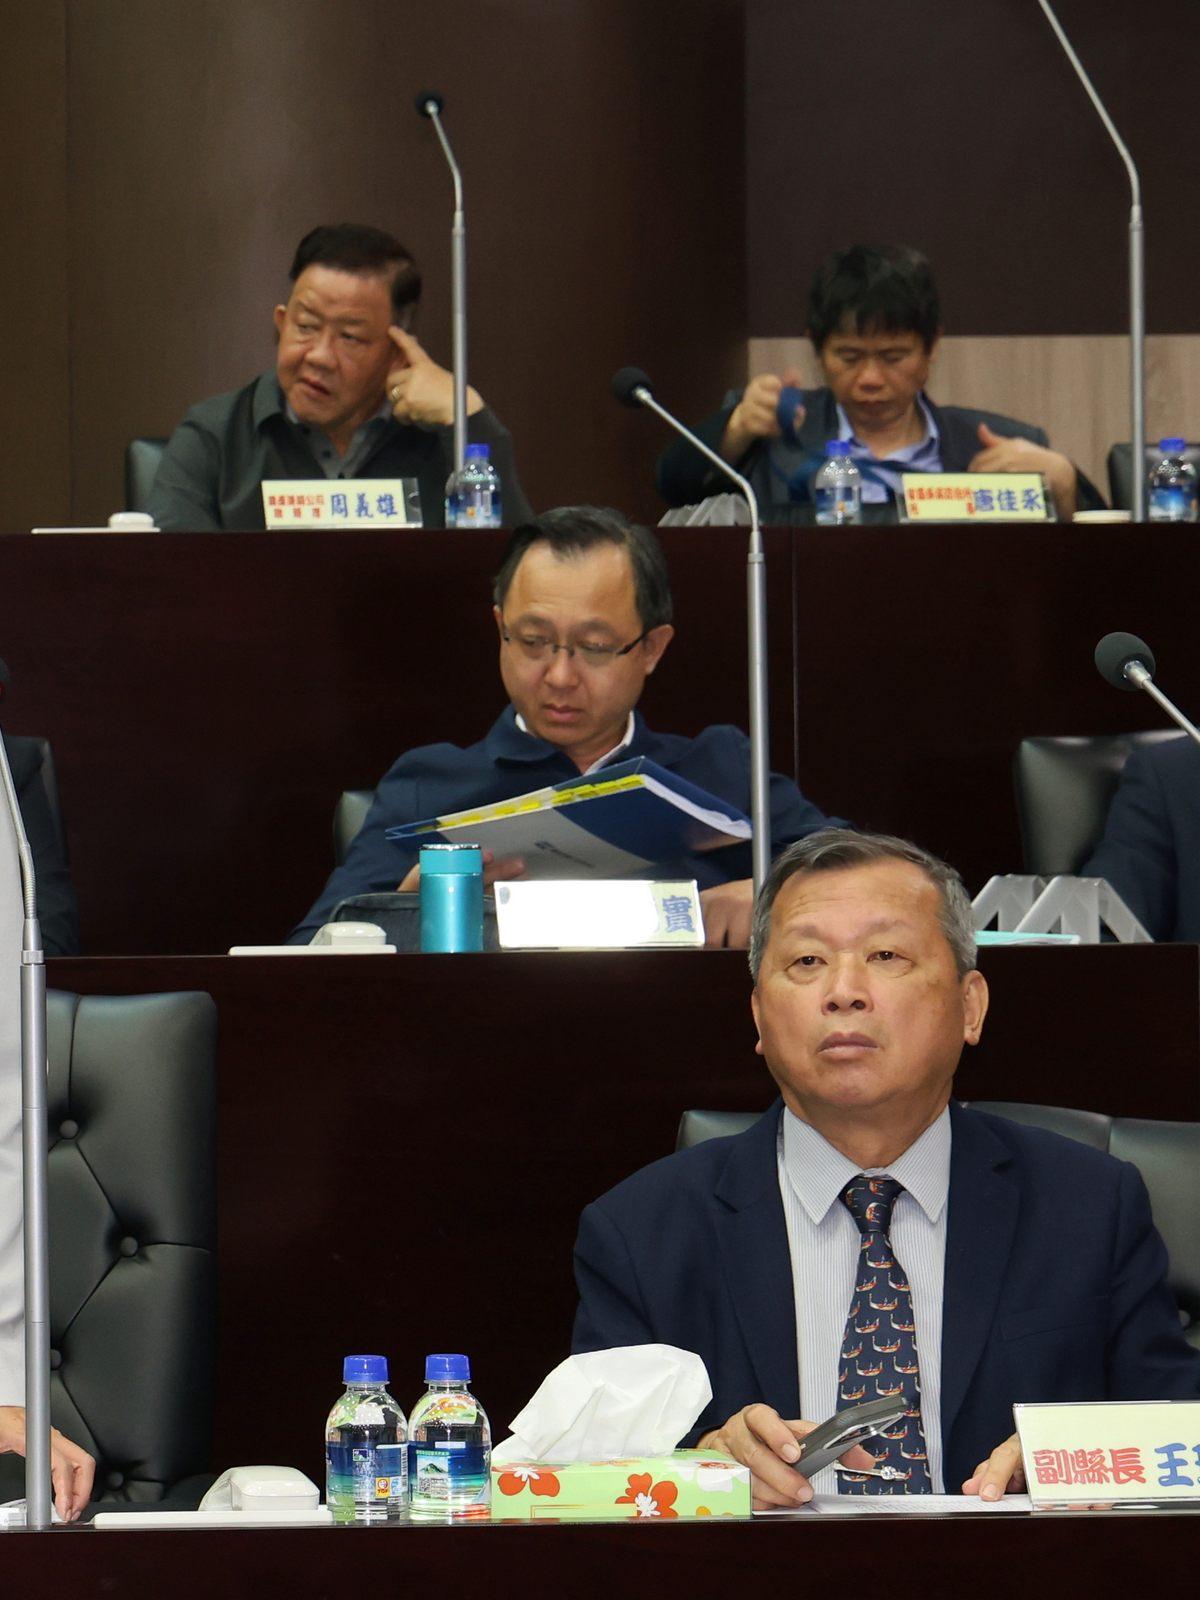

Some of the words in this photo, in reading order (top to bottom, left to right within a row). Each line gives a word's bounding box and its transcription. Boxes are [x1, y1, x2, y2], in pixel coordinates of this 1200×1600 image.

[331, 493, 398, 518] 周義雄
[1032, 1447, 1146, 1485] 副縣長
[1154, 1442, 1200, 1487] 王
